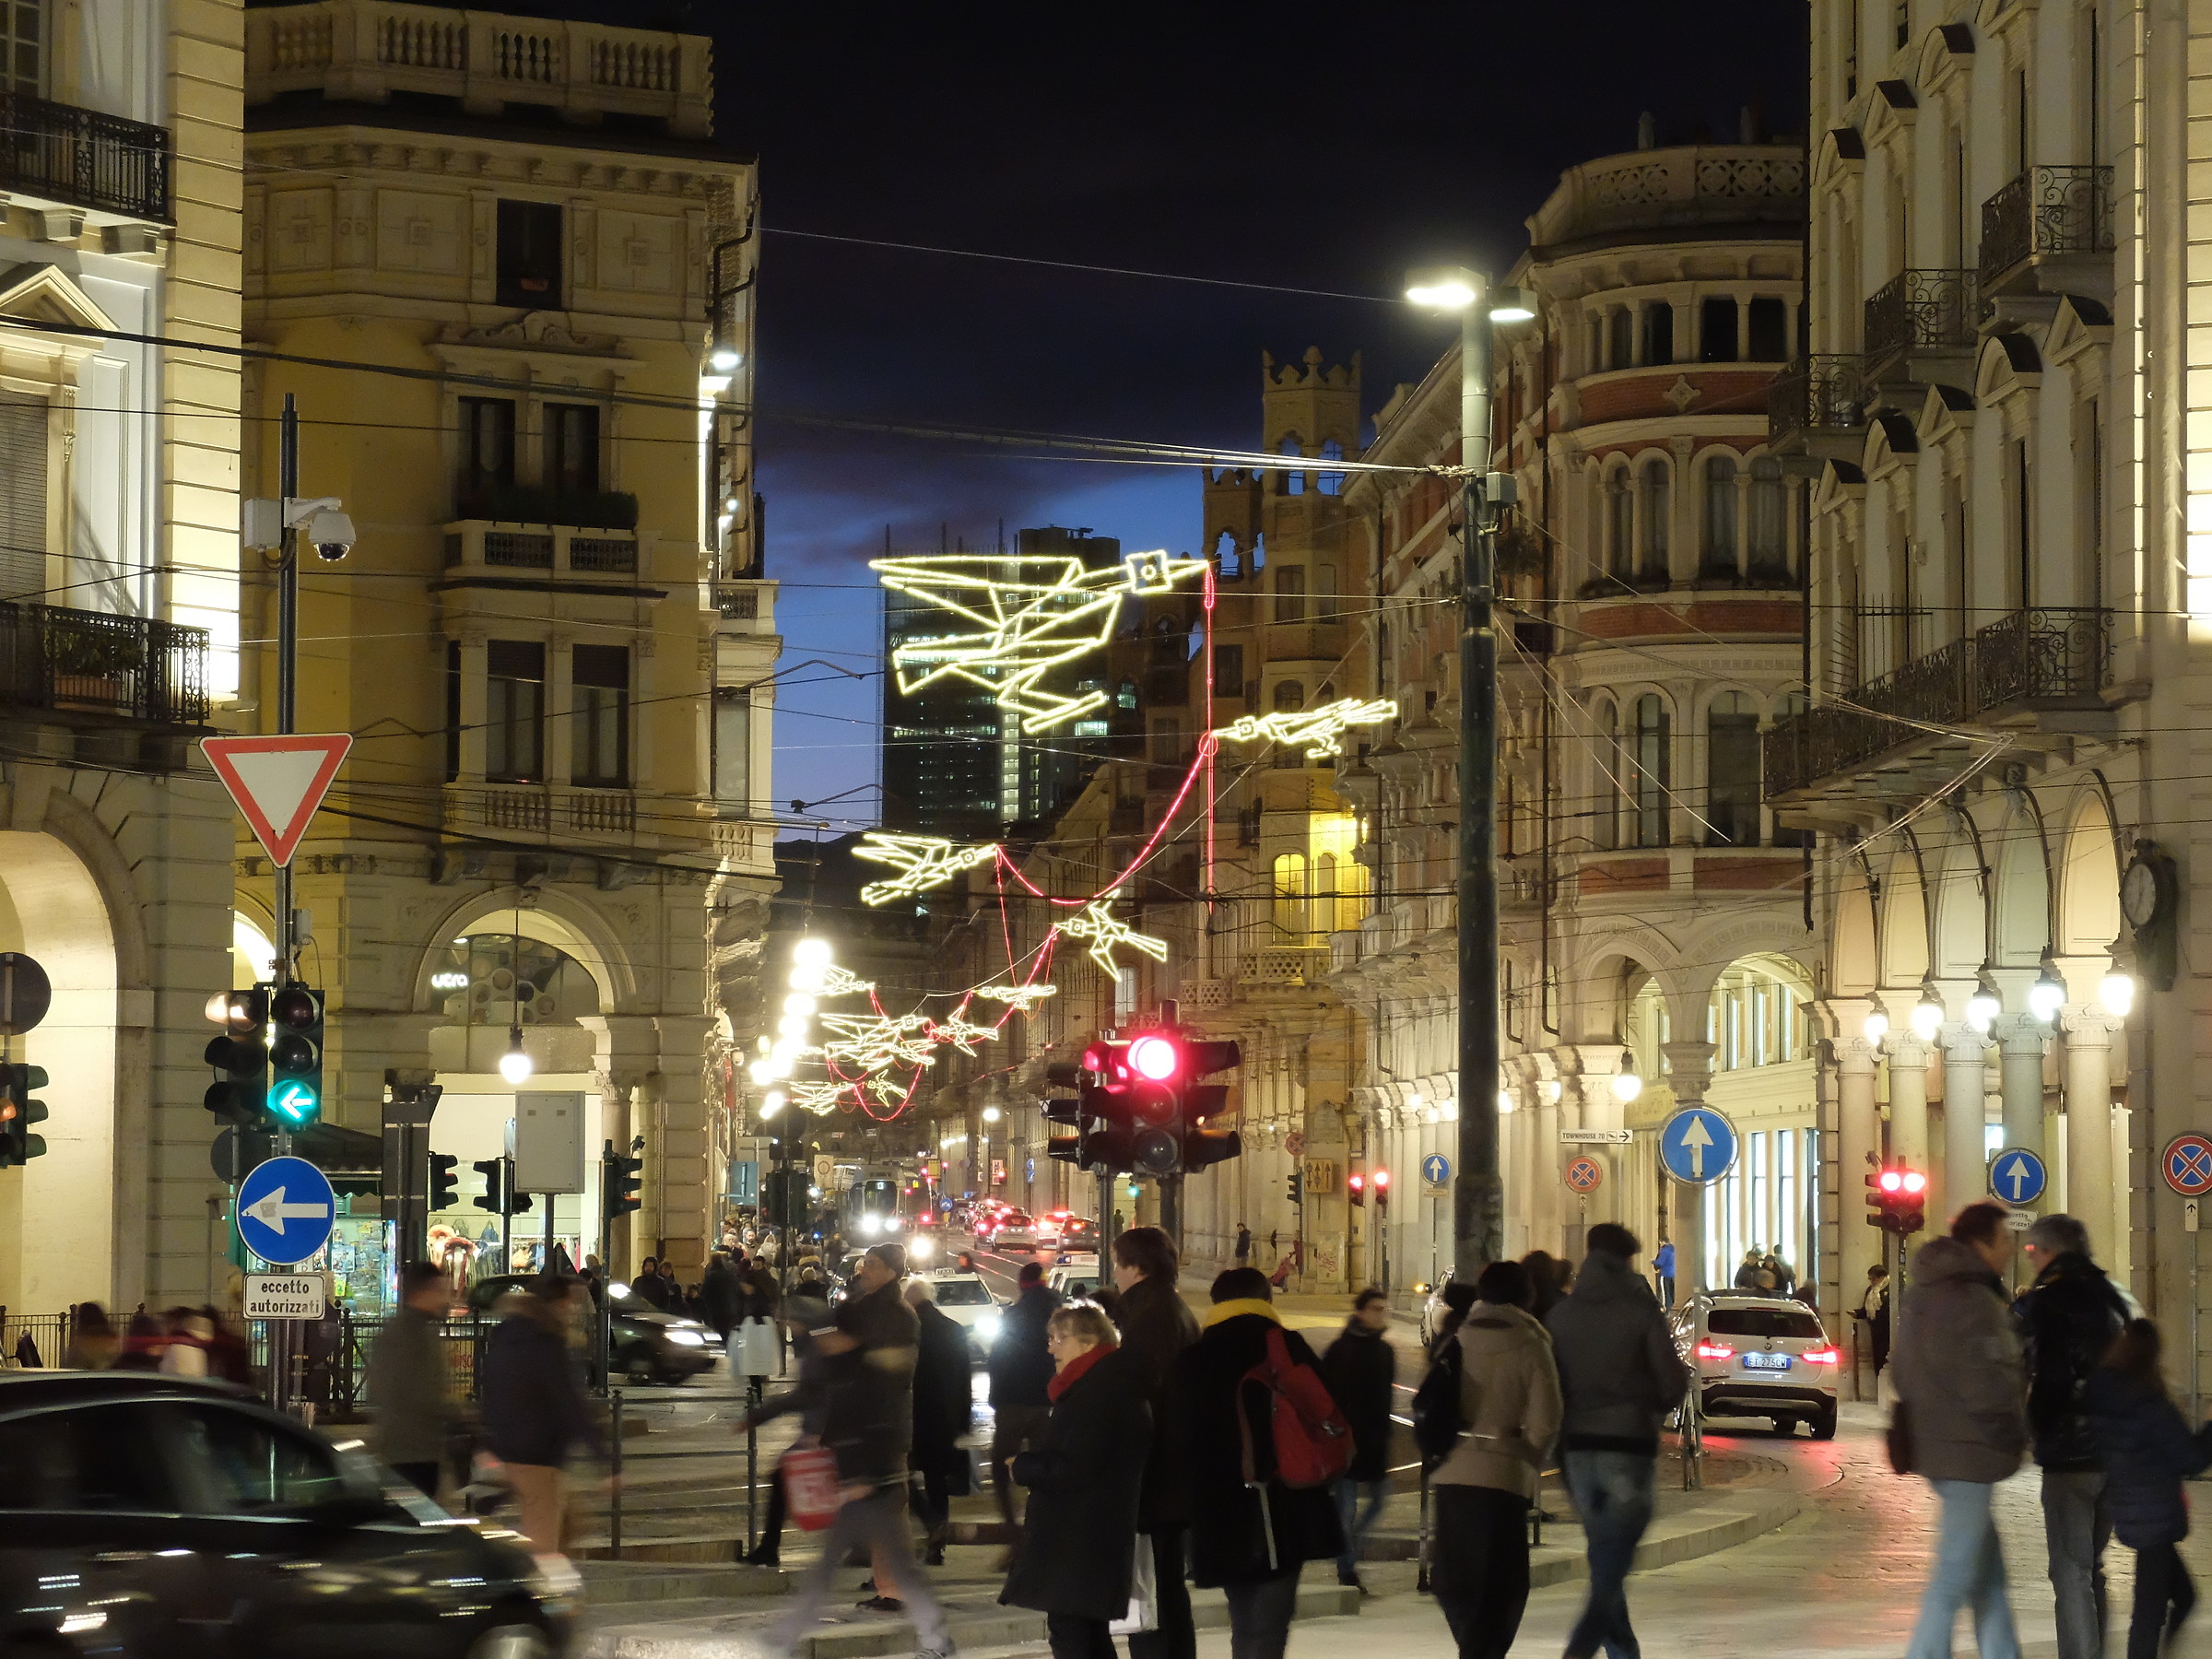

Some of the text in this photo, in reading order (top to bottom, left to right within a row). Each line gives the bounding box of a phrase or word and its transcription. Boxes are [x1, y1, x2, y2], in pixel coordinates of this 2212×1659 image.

[261, 1279, 310, 1294] eccetto
[250, 1299, 319, 1313] autorizzati
[1748, 1358, 1759, 1366] ET
